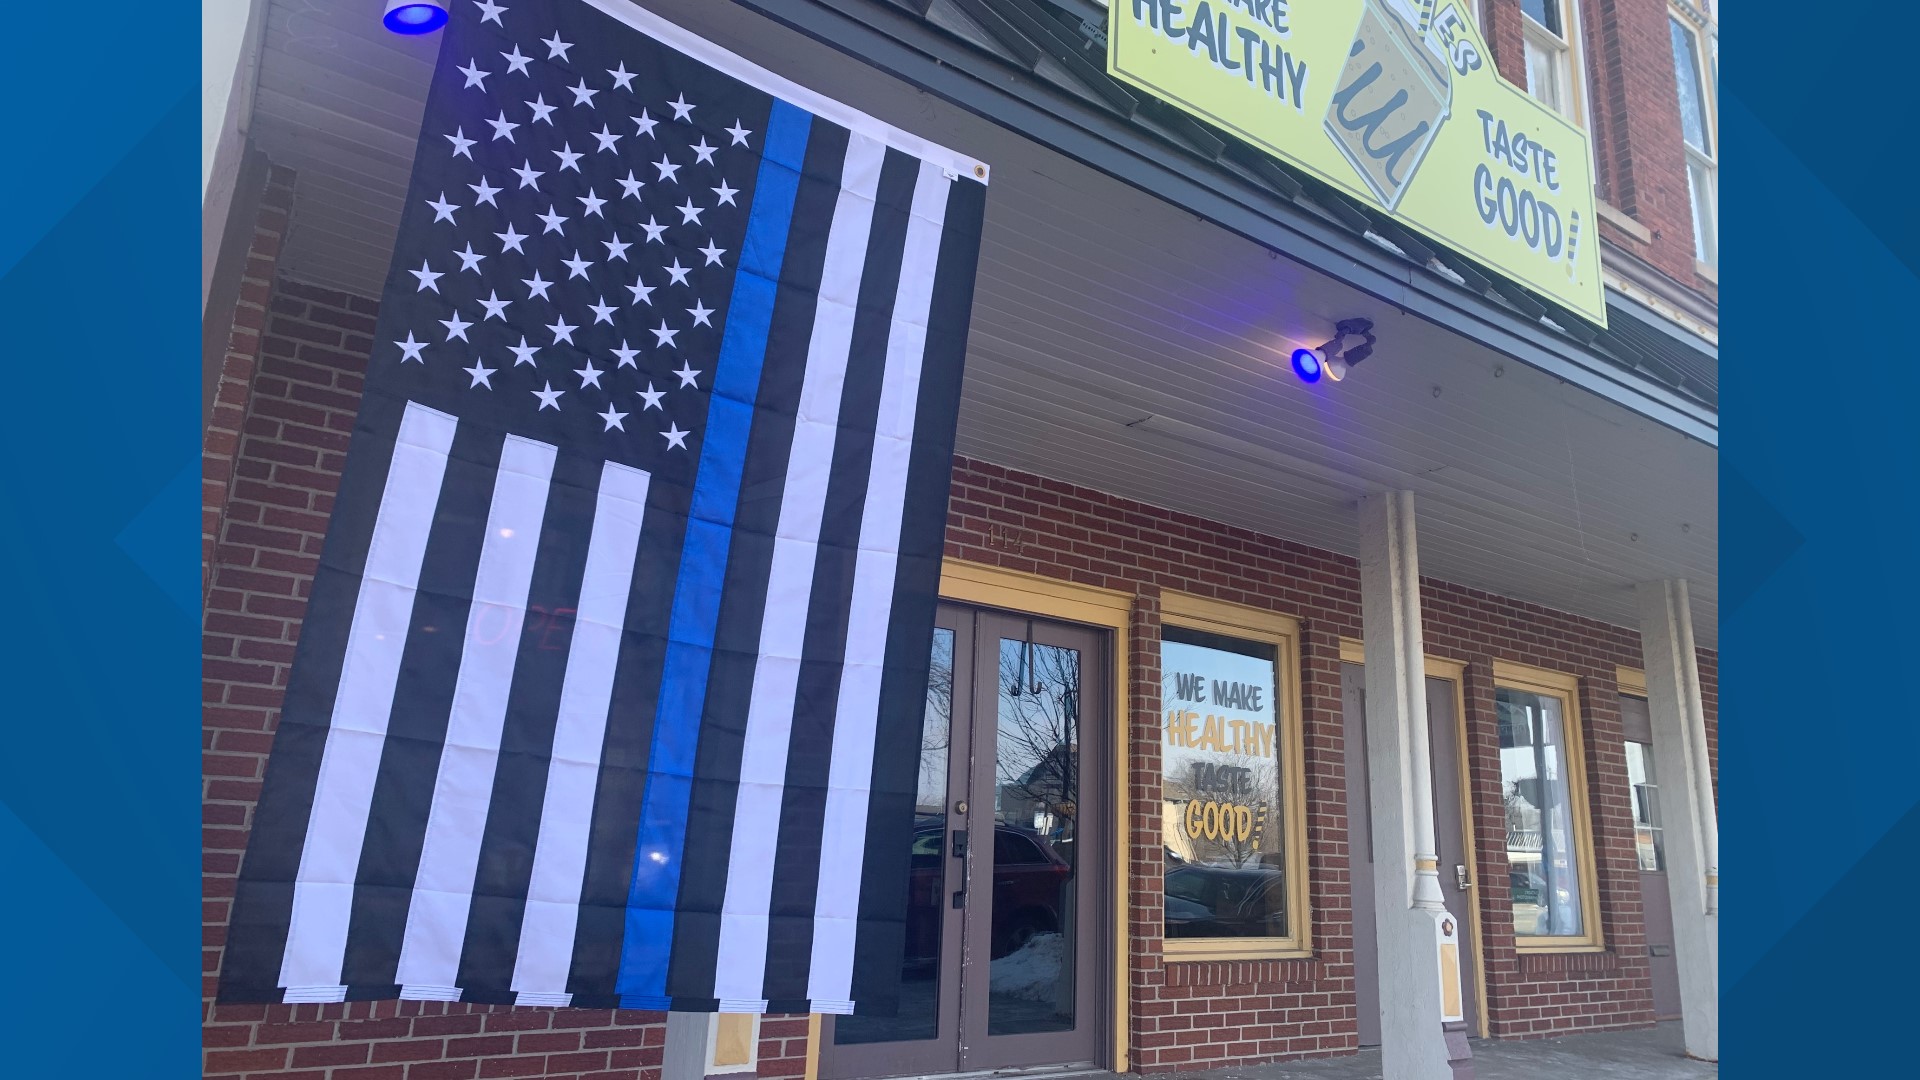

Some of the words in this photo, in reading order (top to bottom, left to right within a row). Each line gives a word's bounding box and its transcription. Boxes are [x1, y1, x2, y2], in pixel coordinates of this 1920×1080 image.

[1226, 0, 1289, 33] KE
[1476, 109, 1559, 190] TASTE
[1474, 163, 1580, 278] GOOD!
[988, 524, 1026, 557] 114
[473, 603, 579, 650] OPE
[1176, 672, 1206, 702] WE
[1212, 679, 1264, 712] MAKE
[1167, 709, 1275, 758] HEALTHY
[1191, 762, 1251, 794] TASTE
[1184, 799, 1267, 850] GOOD!
